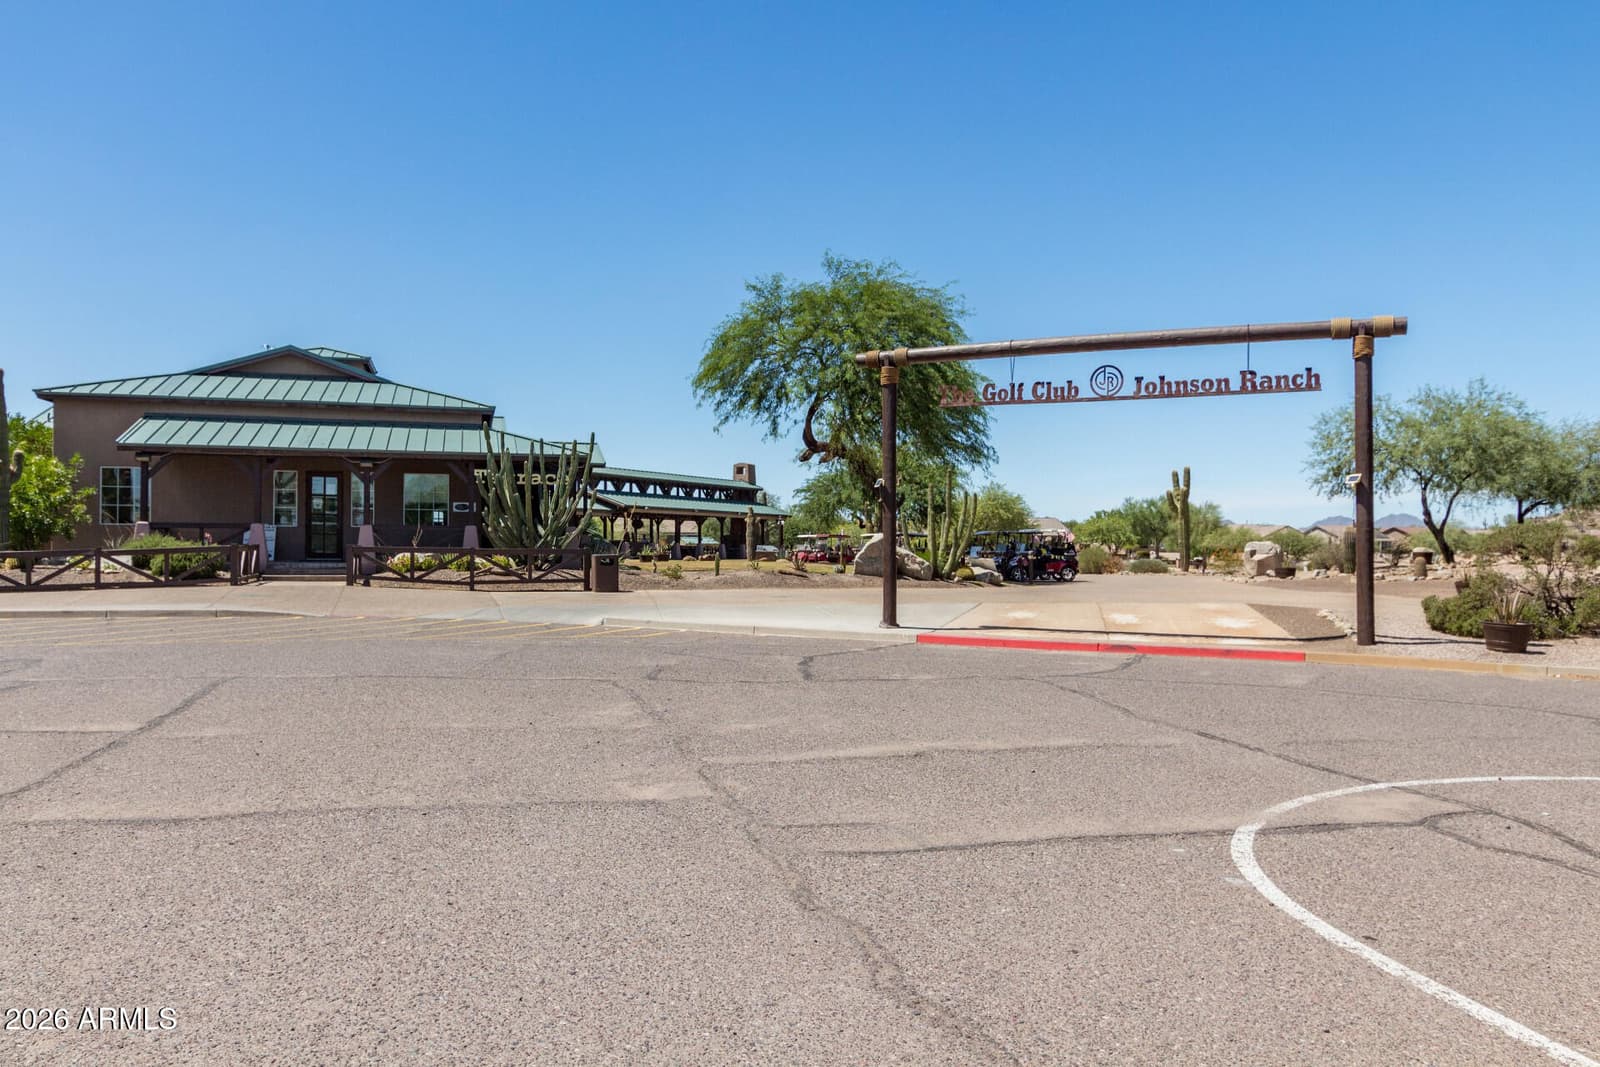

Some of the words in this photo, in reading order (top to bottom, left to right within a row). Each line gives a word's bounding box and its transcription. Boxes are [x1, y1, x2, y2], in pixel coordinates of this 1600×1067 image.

[982, 382, 1025, 402] Golf
[1031, 380, 1080, 401] Club
[1133, 375, 1231, 398] Johnson
[1239, 367, 1322, 391] Ranch
